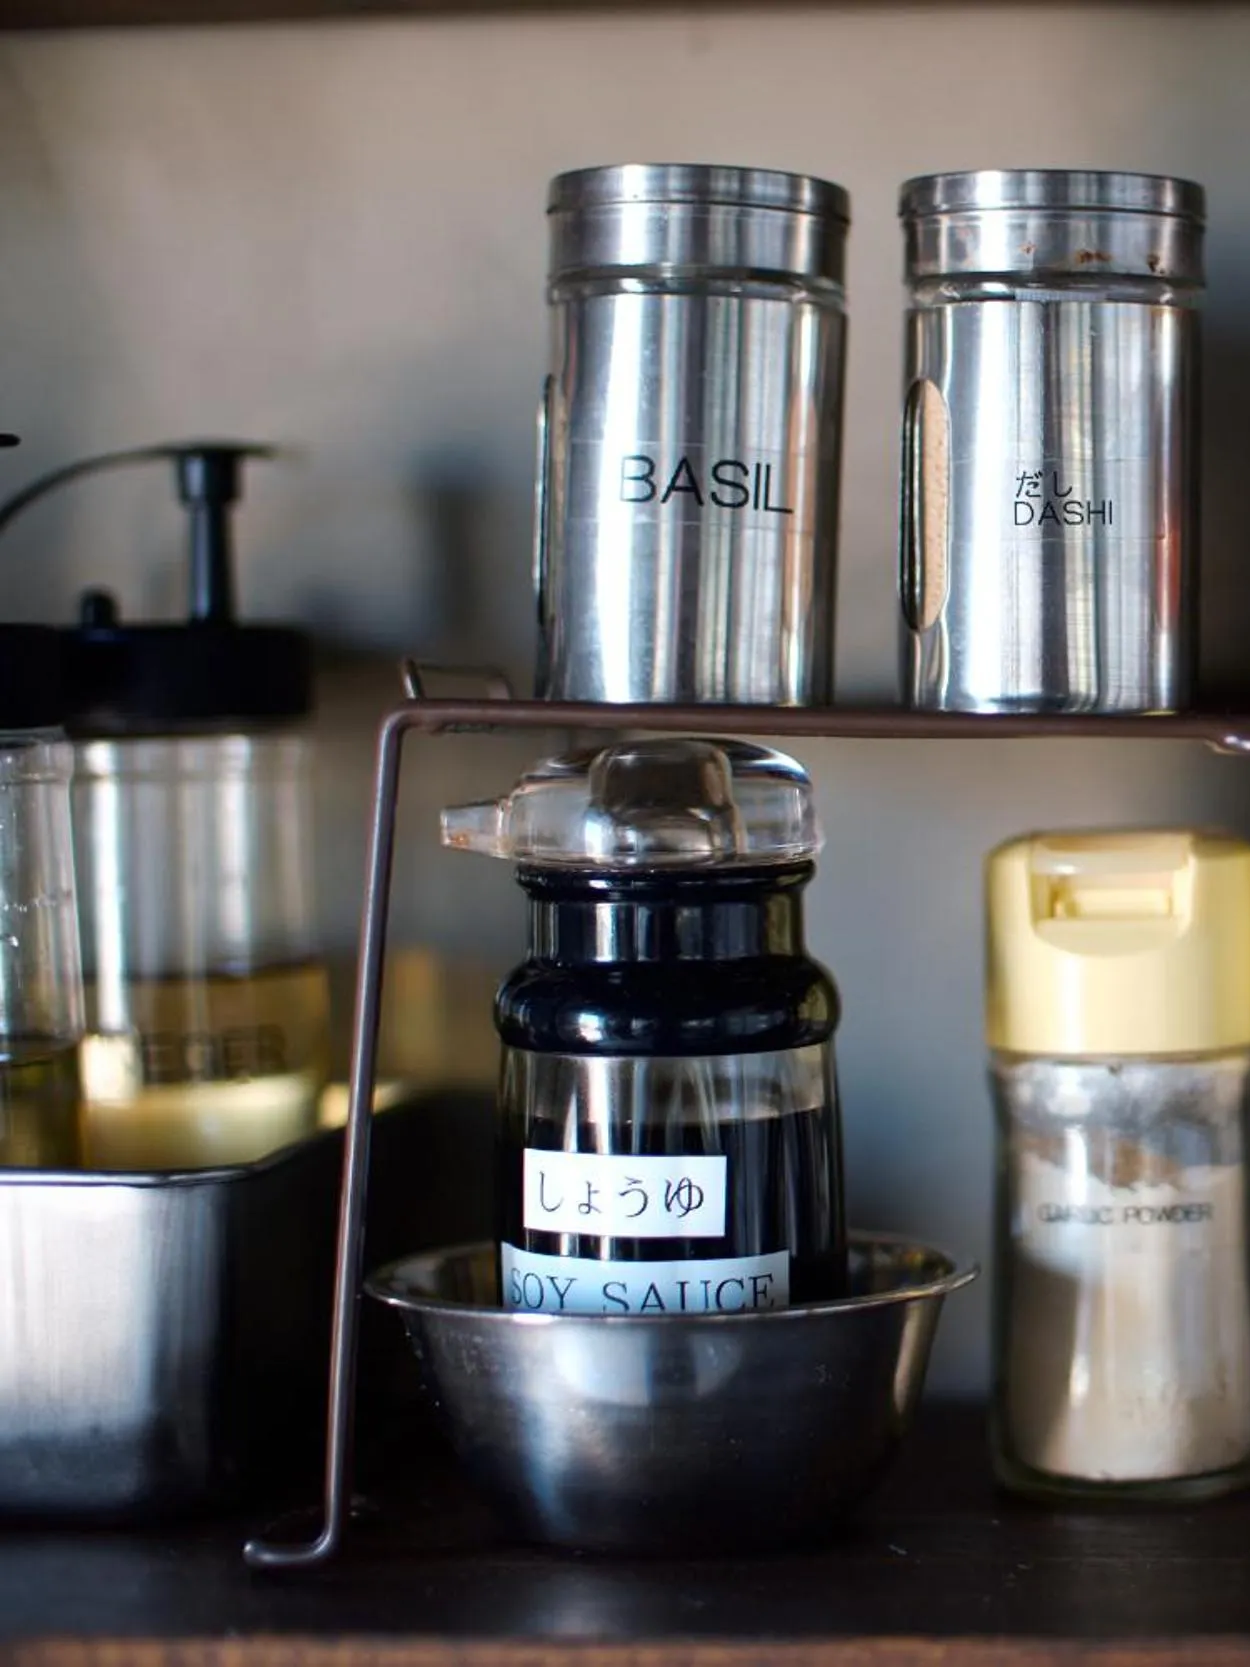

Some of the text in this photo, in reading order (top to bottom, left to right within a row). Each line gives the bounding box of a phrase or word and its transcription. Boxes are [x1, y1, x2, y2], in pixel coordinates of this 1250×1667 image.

[620, 455, 794, 514] BASIL
[1016, 471, 1073, 498] だし
[1014, 499, 1113, 526] DASHI
[539, 1170, 705, 1219] しょうゆ
[1123, 1201, 1215, 1225] POWDER
[509, 1266, 774, 1314] SOY SAUCE
